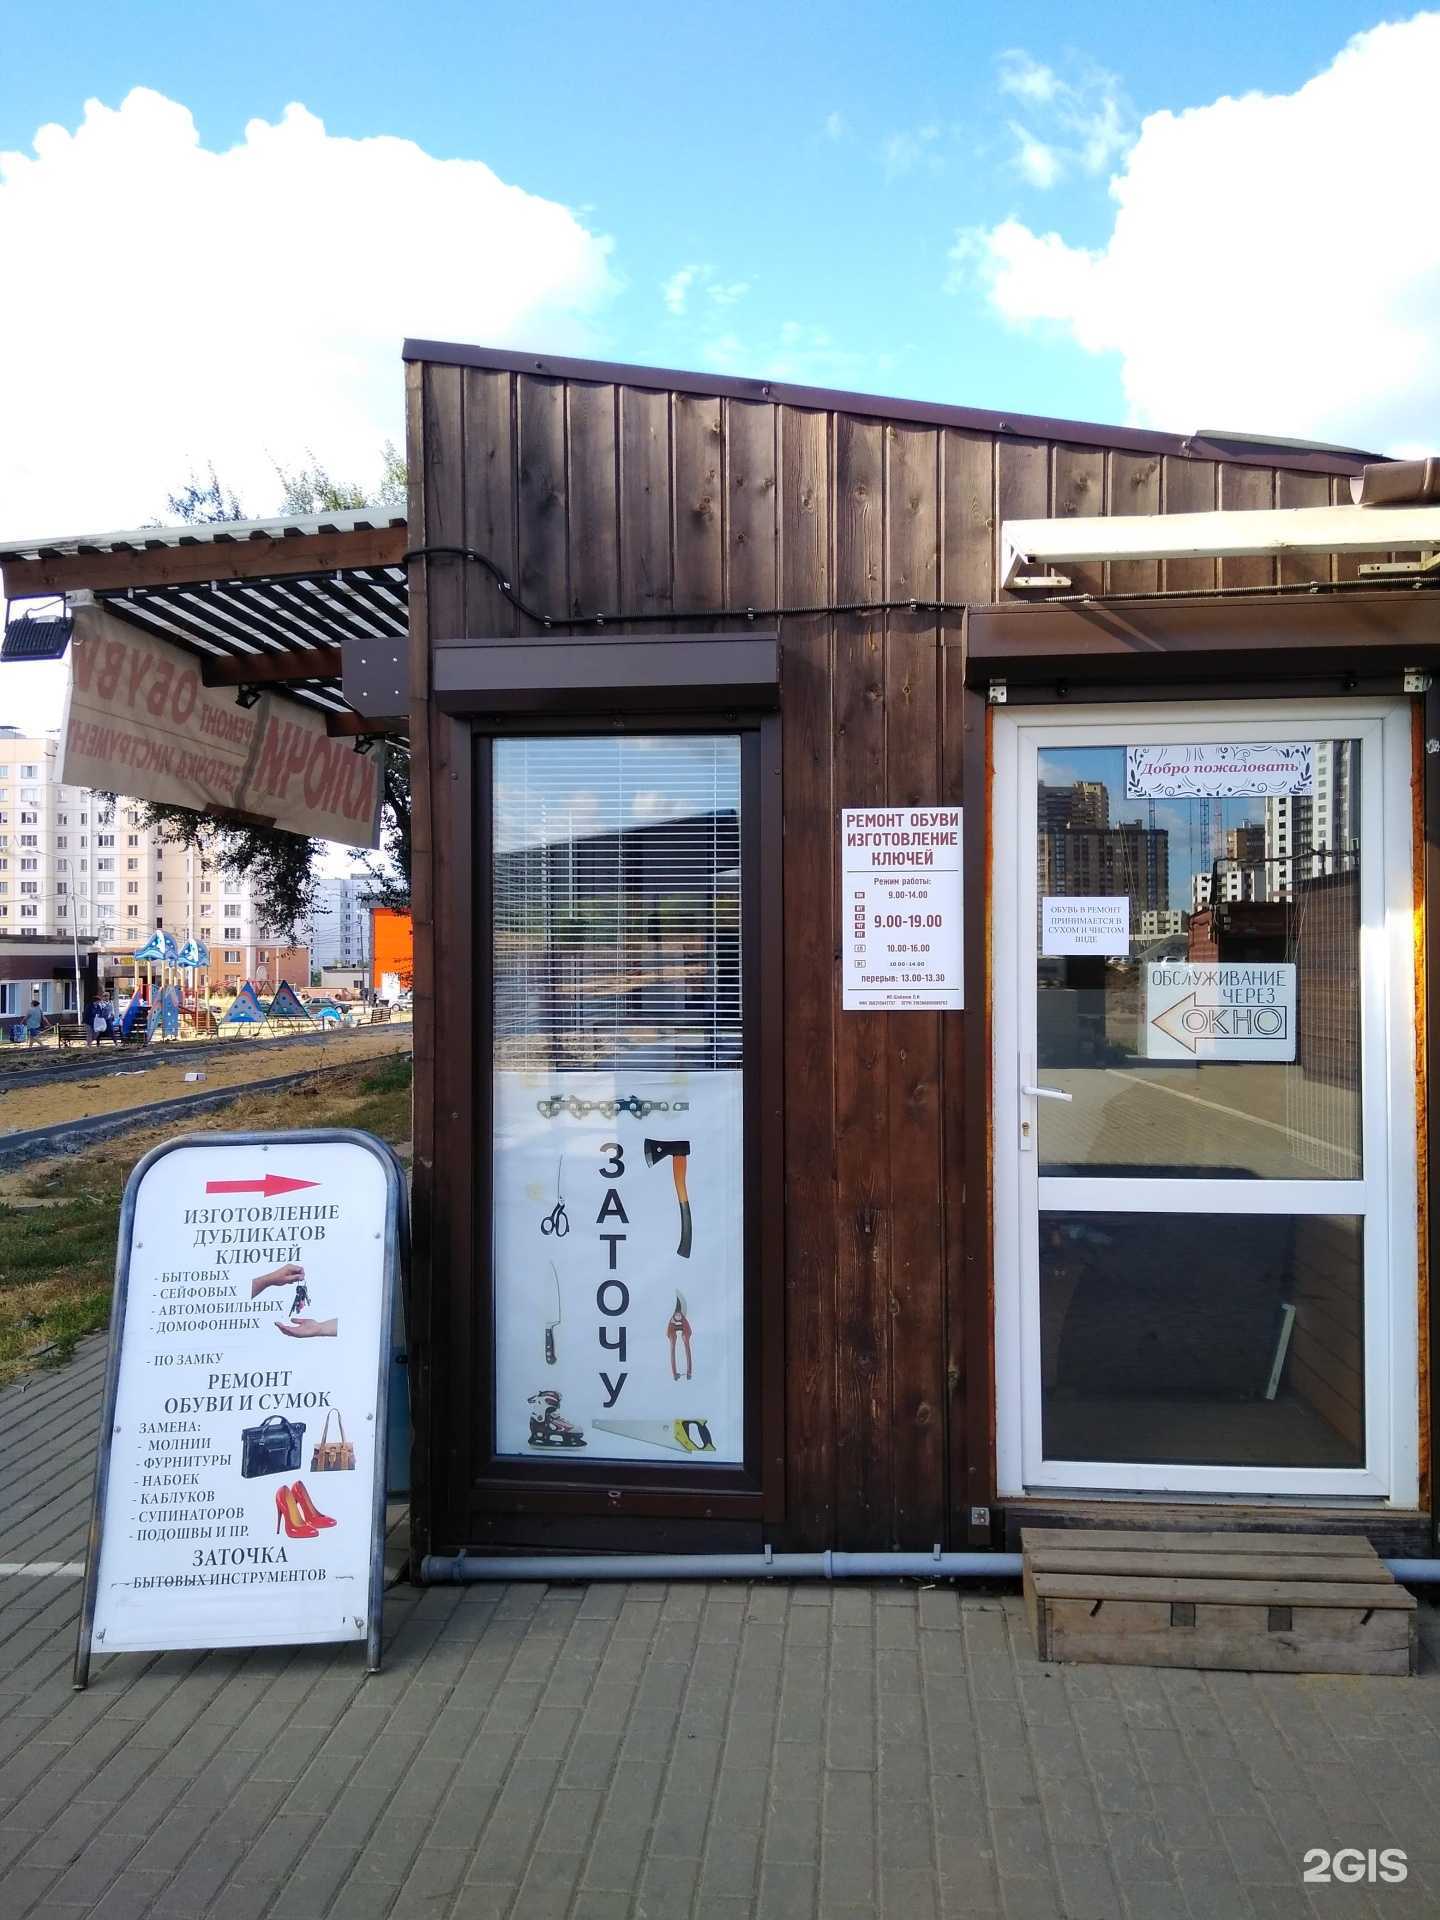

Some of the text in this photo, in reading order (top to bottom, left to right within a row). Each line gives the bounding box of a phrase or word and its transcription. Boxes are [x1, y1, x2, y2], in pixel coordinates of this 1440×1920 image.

[1141, 761, 1298, 776] Добро пожаловать
[846, 813, 959, 828] РЕМОНТ ОБУВИ
[847, 832, 958, 846] ИЗГОТОВЛЕНИЕ
[871, 849, 934, 866] КЛЮЧЕЙ
[874, 877, 932, 887] Режим работы:
[888, 891, 928, 899] 9.00-14.00
[1051, 906, 1078, 914] ОБУВЬ
[1087, 906, 1120, 914] РЕМОНТ
[874, 914, 943, 928] 9.00-19.00
[1051, 917, 1114, 925] ПРИНИМАЕТСЯ
[1048, 926, 1080, 934] СУХОМ
[1089, 926, 1124, 934] ЧИСТОМ
[861, 974, 945, 984] перерыв: 13.00-13.30
[1152, 970, 1287, 986] ОБСЛУЖИВАНИЕ
[1223, 988, 1275, 1004] ЧЕРЕЗ
[1181, 1007, 1283, 1035] ОКНО
[184, 1204, 340, 1224] ИЗГОТОВЛЕНИЕ
[193, 1225, 326, 1248] ДУБЛИКАТОВ
[216, 1244, 303, 1265] КЛЮЧЕЙ
[162, 1270, 231, 1283] БЫТОВЫХ
[595, 1142, 630, 1408] ЗАТОЧУ
[160, 1285, 238, 1299] СЕЙФОВЫХ
[159, 1301, 284, 1316] АВТОМОБИЛЬНЫХ
[156, 1318, 261, 1334] ДОМОФОННЫХ
[154, 1353, 225, 1366] ПО ЗАМКУ
[207, 1370, 293, 1390] РЕМОНТ
[164, 1391, 332, 1414] ОБУВИ И СУМОК
[139, 1421, 201, 1434] ЗАМЕНА:
[149, 1437, 212, 1451] МОЛНИИ
[144, 1454, 232, 1469] ФУРНИТУРЫ
[142, 1473, 201, 1487] НАБОЕК
[140, 1490, 215, 1505] КАБЛУКОВ
[138, 1507, 245, 1523] СУПИНАТОРОВ
[136, 1525, 250, 1543] ПОДОШВЫ И ПР.
[192, 1546, 289, 1567] ЗАТОЧКА
[133, 1568, 327, 1589] БЫТОВЫХ ИНСТРУМЕНТОВ
